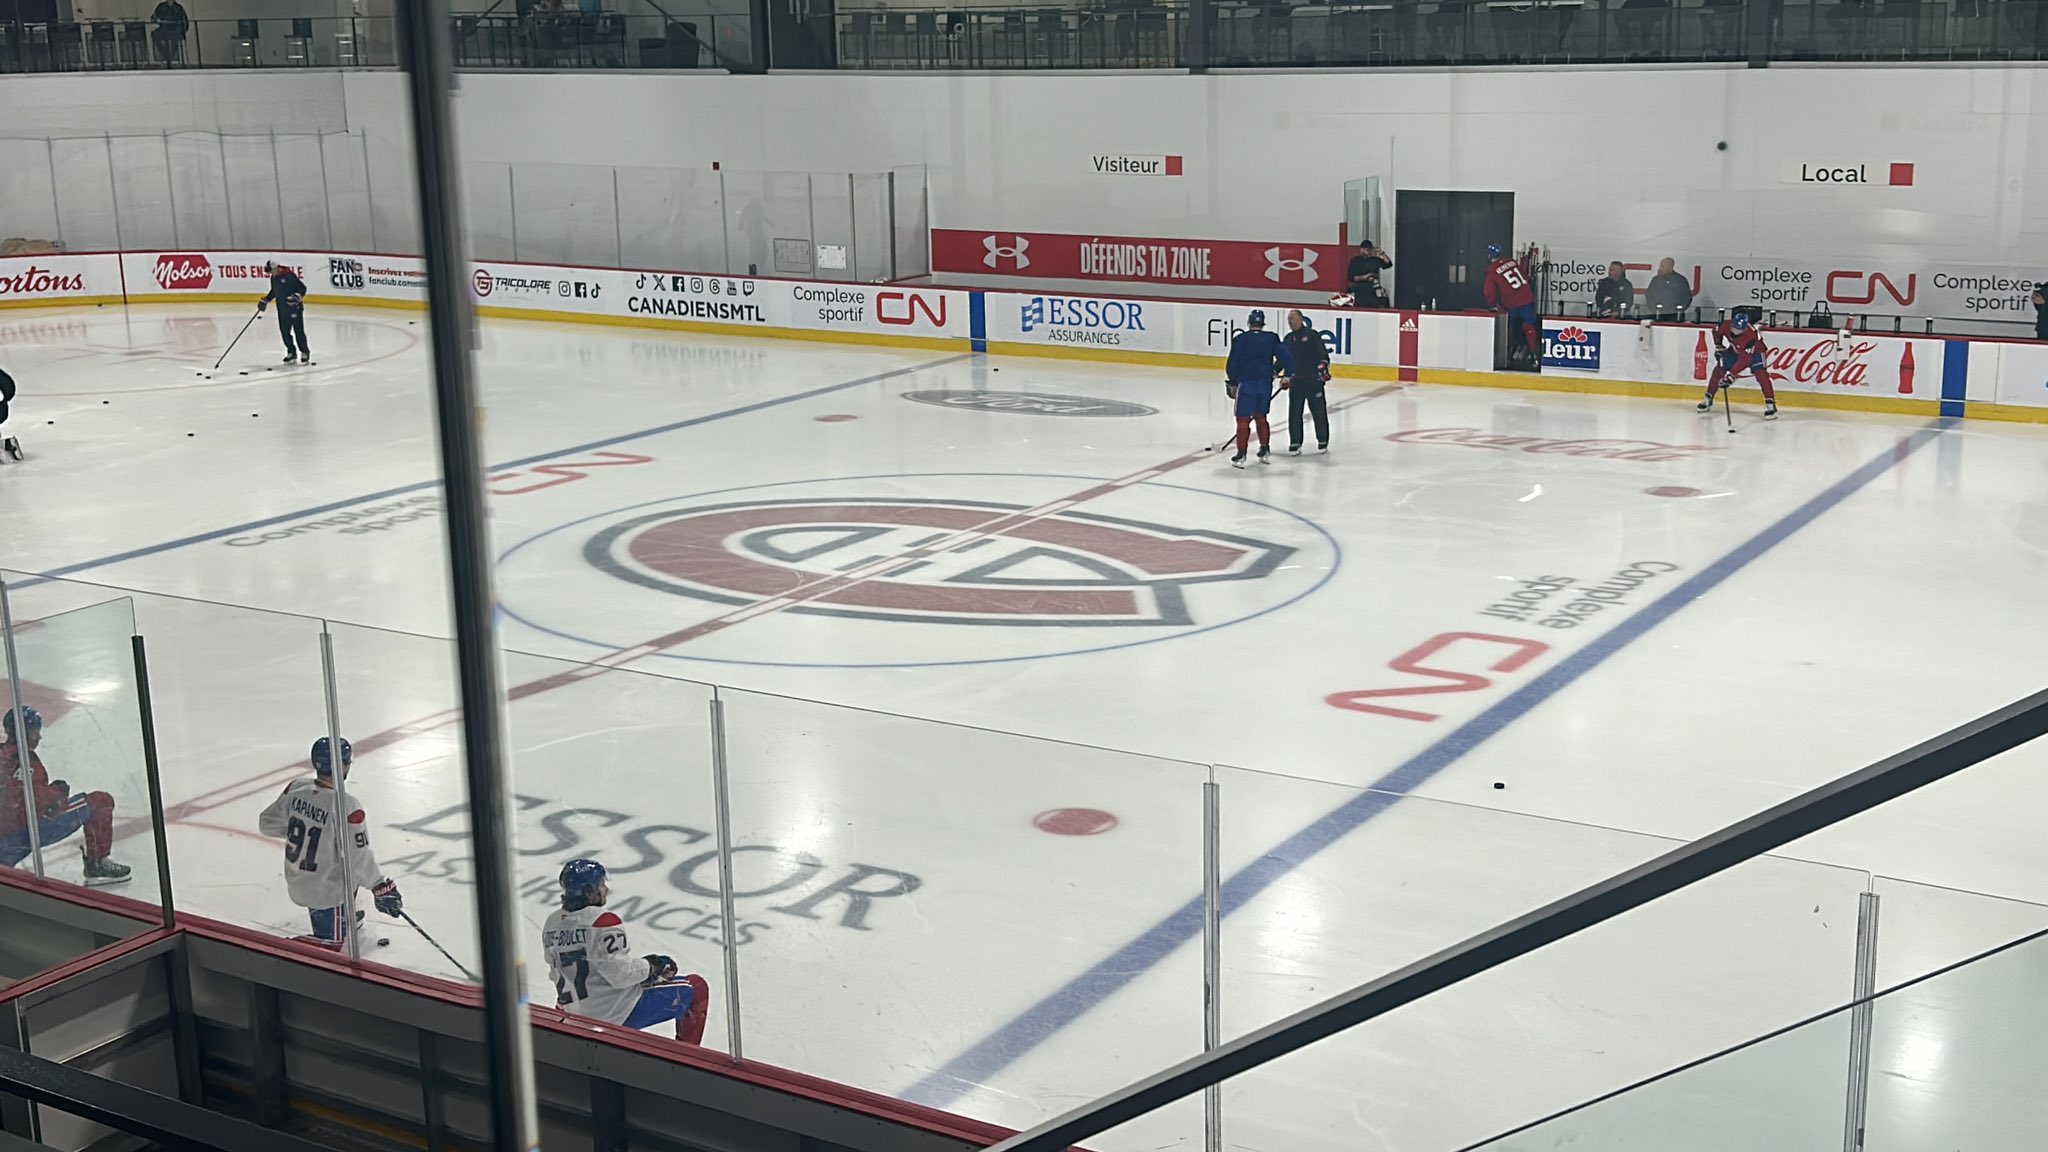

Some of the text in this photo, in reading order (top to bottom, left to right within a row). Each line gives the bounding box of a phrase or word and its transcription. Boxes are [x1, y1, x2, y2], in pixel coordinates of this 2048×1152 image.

[1093, 156, 1159, 173] Visiteur
[1801, 163, 1867, 183] Local
[330, 260, 354, 273] FAN
[1080, 238, 1211, 280] DÉFENDS TA ZONE
[1535, 260, 1606, 278] omplexe
[152, 260, 215, 289] Molson
[218, 265, 248, 279] TOUS
[332, 275, 364, 288] CLUB
[1503, 267, 1527, 289] 51
[1721, 265, 1813, 285] Complexe
[495, 277, 552, 290] TRICOLORE
[1550, 278, 1598, 295] sporti
[1825, 270, 1917, 307] CN
[1933, 273, 2033, 294] Complexe
[793, 286, 865, 305] Complexe
[1750, 286, 1810, 302] sportif
[1965, 294, 2030, 313] sportif
[628, 296, 766, 322] CANADIENSMTL
[818, 307, 864, 323] sportif
[876, 291, 946, 328] CN
[1048, 298, 1146, 330] ESSOR
[1048, 329, 1121, 345] ASSURANCES
[1302, 316, 1352, 355] ell
[1479, 574, 1578, 622] sportif
[1537, 560, 1679, 629] Complexe
[285, 815, 323, 873] 91
[603, 932, 628, 955] 27
